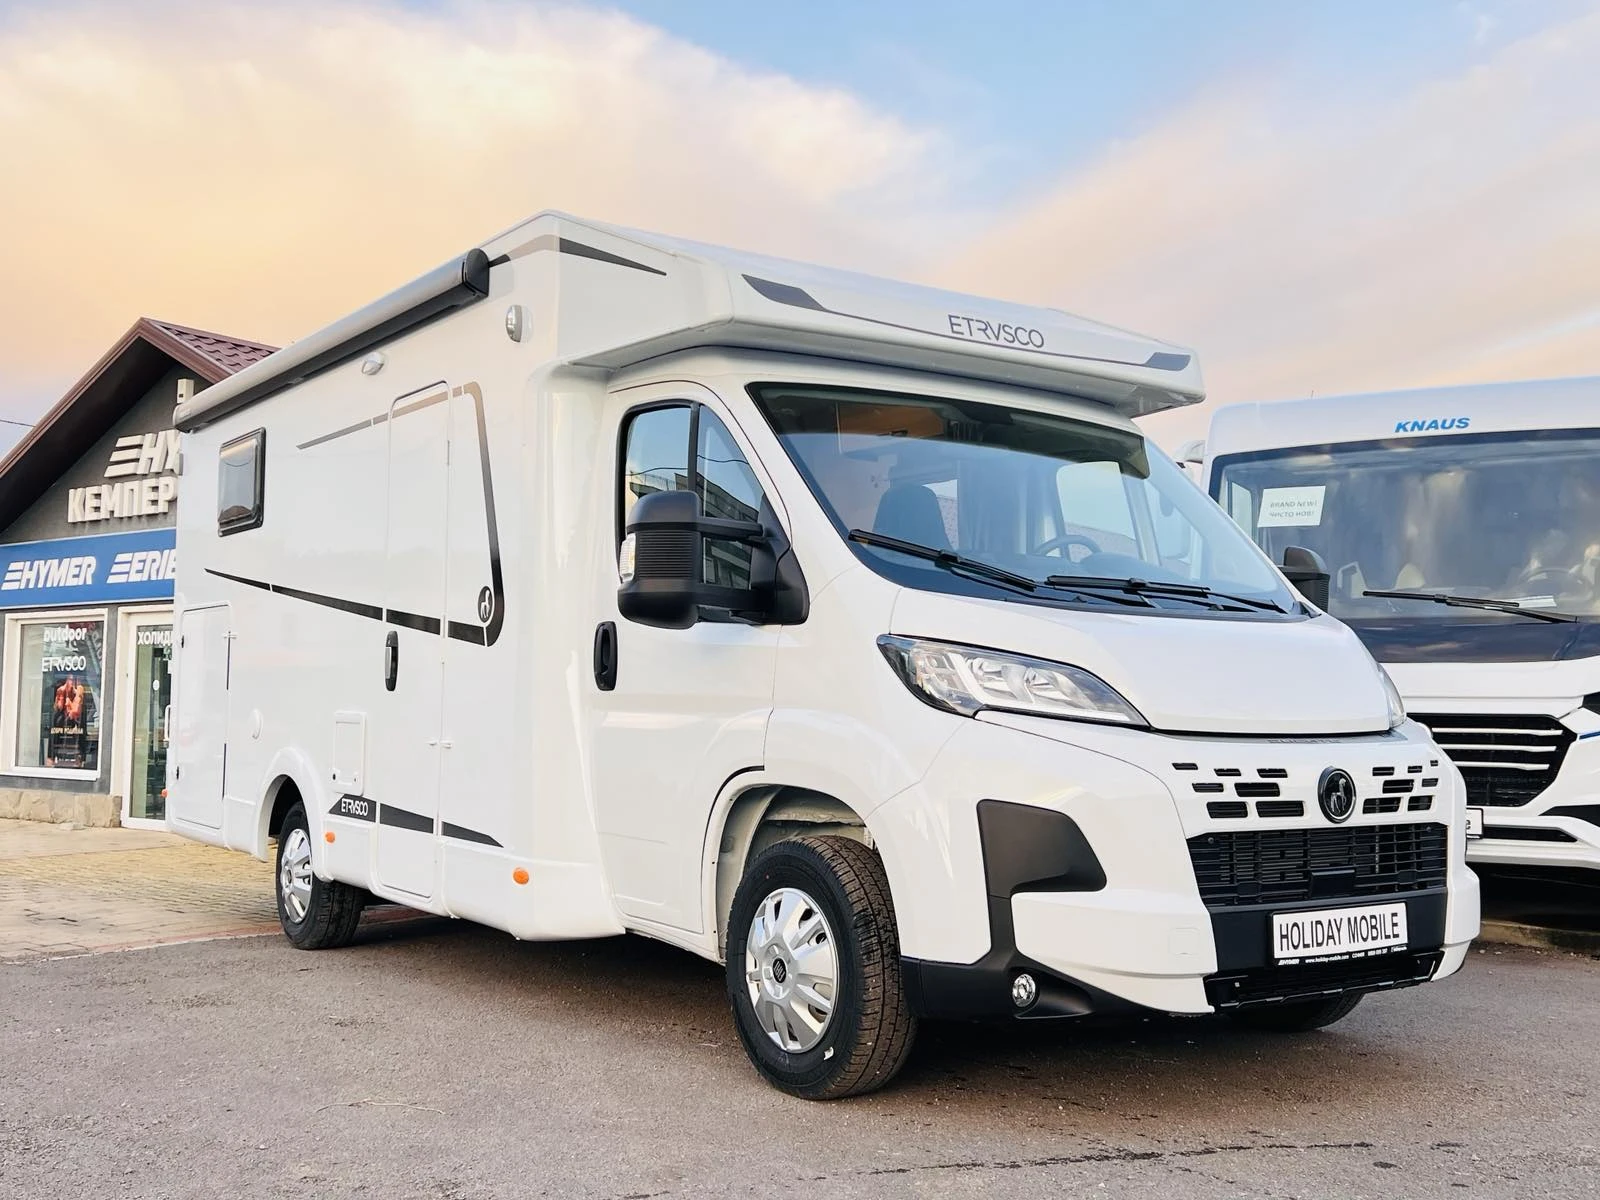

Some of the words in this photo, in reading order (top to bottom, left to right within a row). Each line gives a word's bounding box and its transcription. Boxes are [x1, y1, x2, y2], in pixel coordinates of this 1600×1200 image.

[948, 314, 1045, 348] ETRVSCO
[1394, 417, 1471, 433] KNAUS
[19, 556, 97, 590] HYMER
[1279, 918, 1343, 951] HOLIDAY
[1347, 912, 1400, 944] MOBILE
